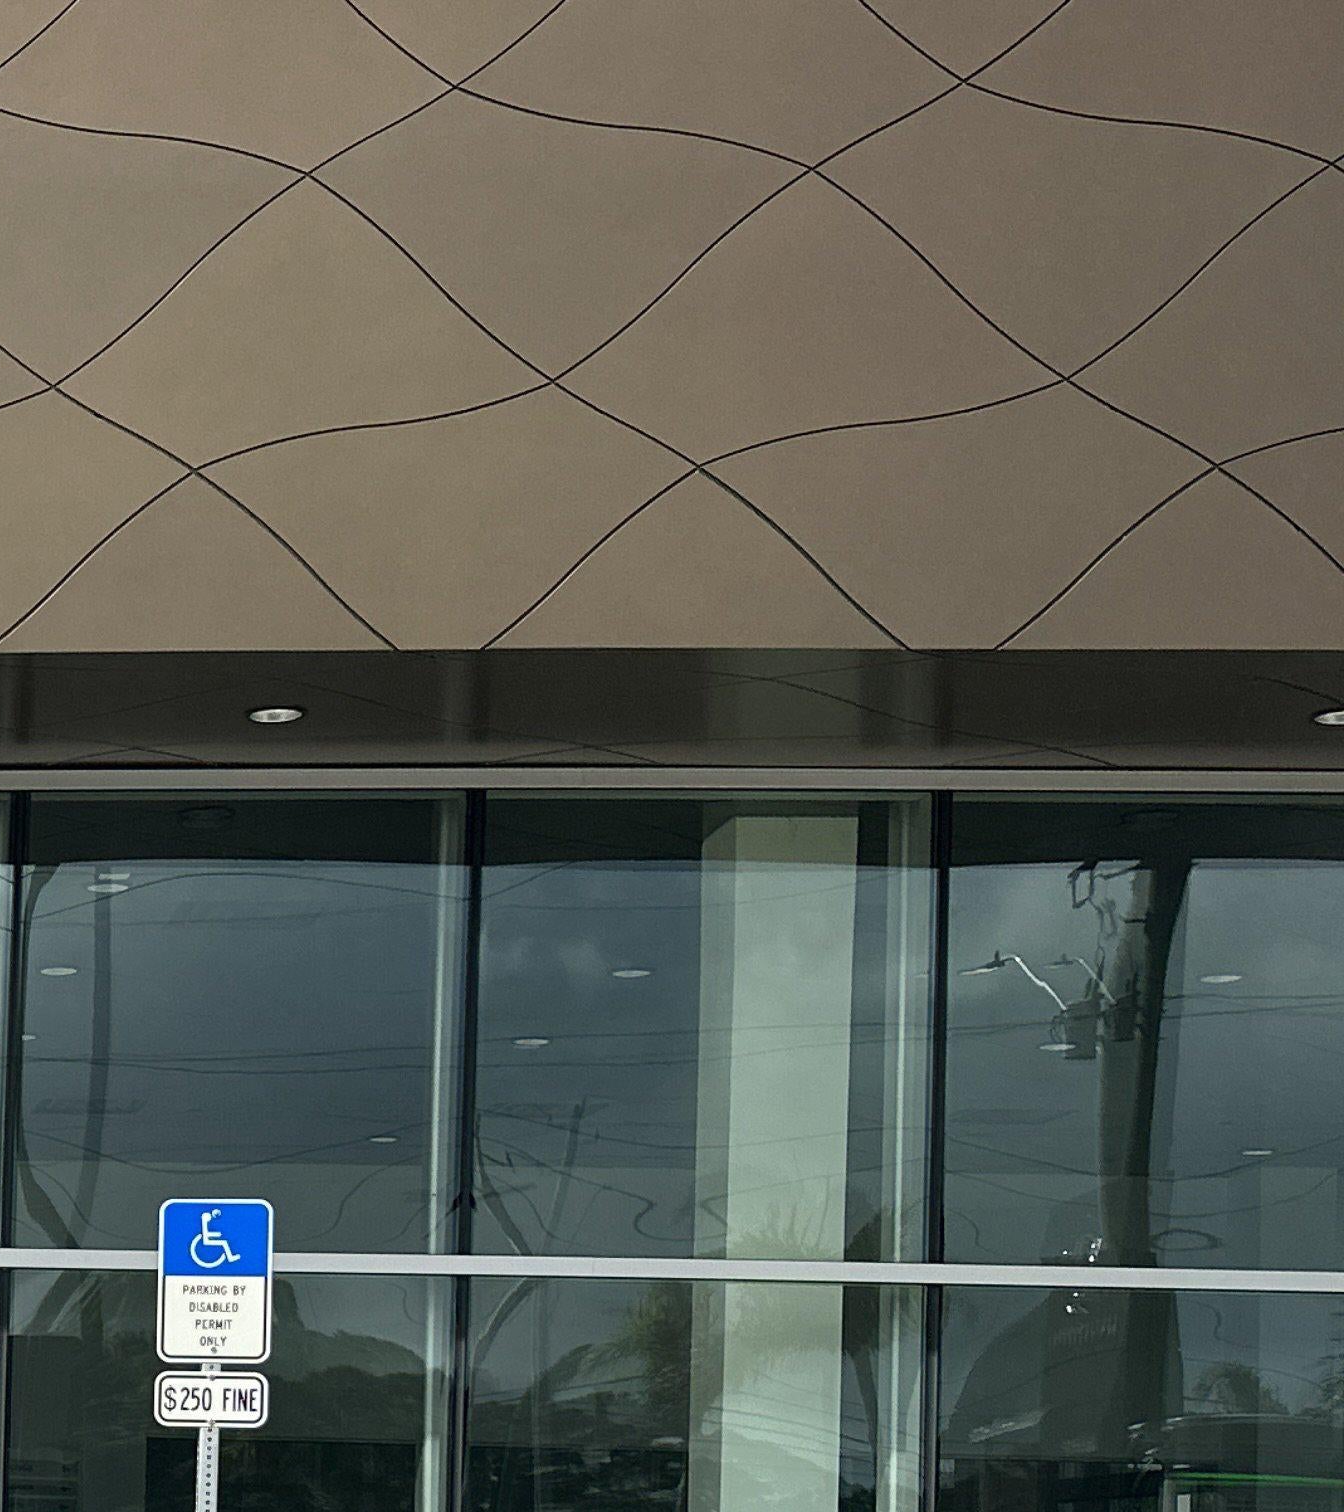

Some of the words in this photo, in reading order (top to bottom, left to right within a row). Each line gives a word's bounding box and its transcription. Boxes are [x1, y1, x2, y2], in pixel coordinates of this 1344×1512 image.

[182, 1285, 227, 1295] PARKING
[233, 1285, 246, 1296] BY
[189, 1302, 239, 1312] DISABLED
[195, 1320, 232, 1330] PERMIT
[199, 1336, 227, 1346] ONLY
[164, 1385, 212, 1412] $250
[223, 1388, 258, 1411] FINE
